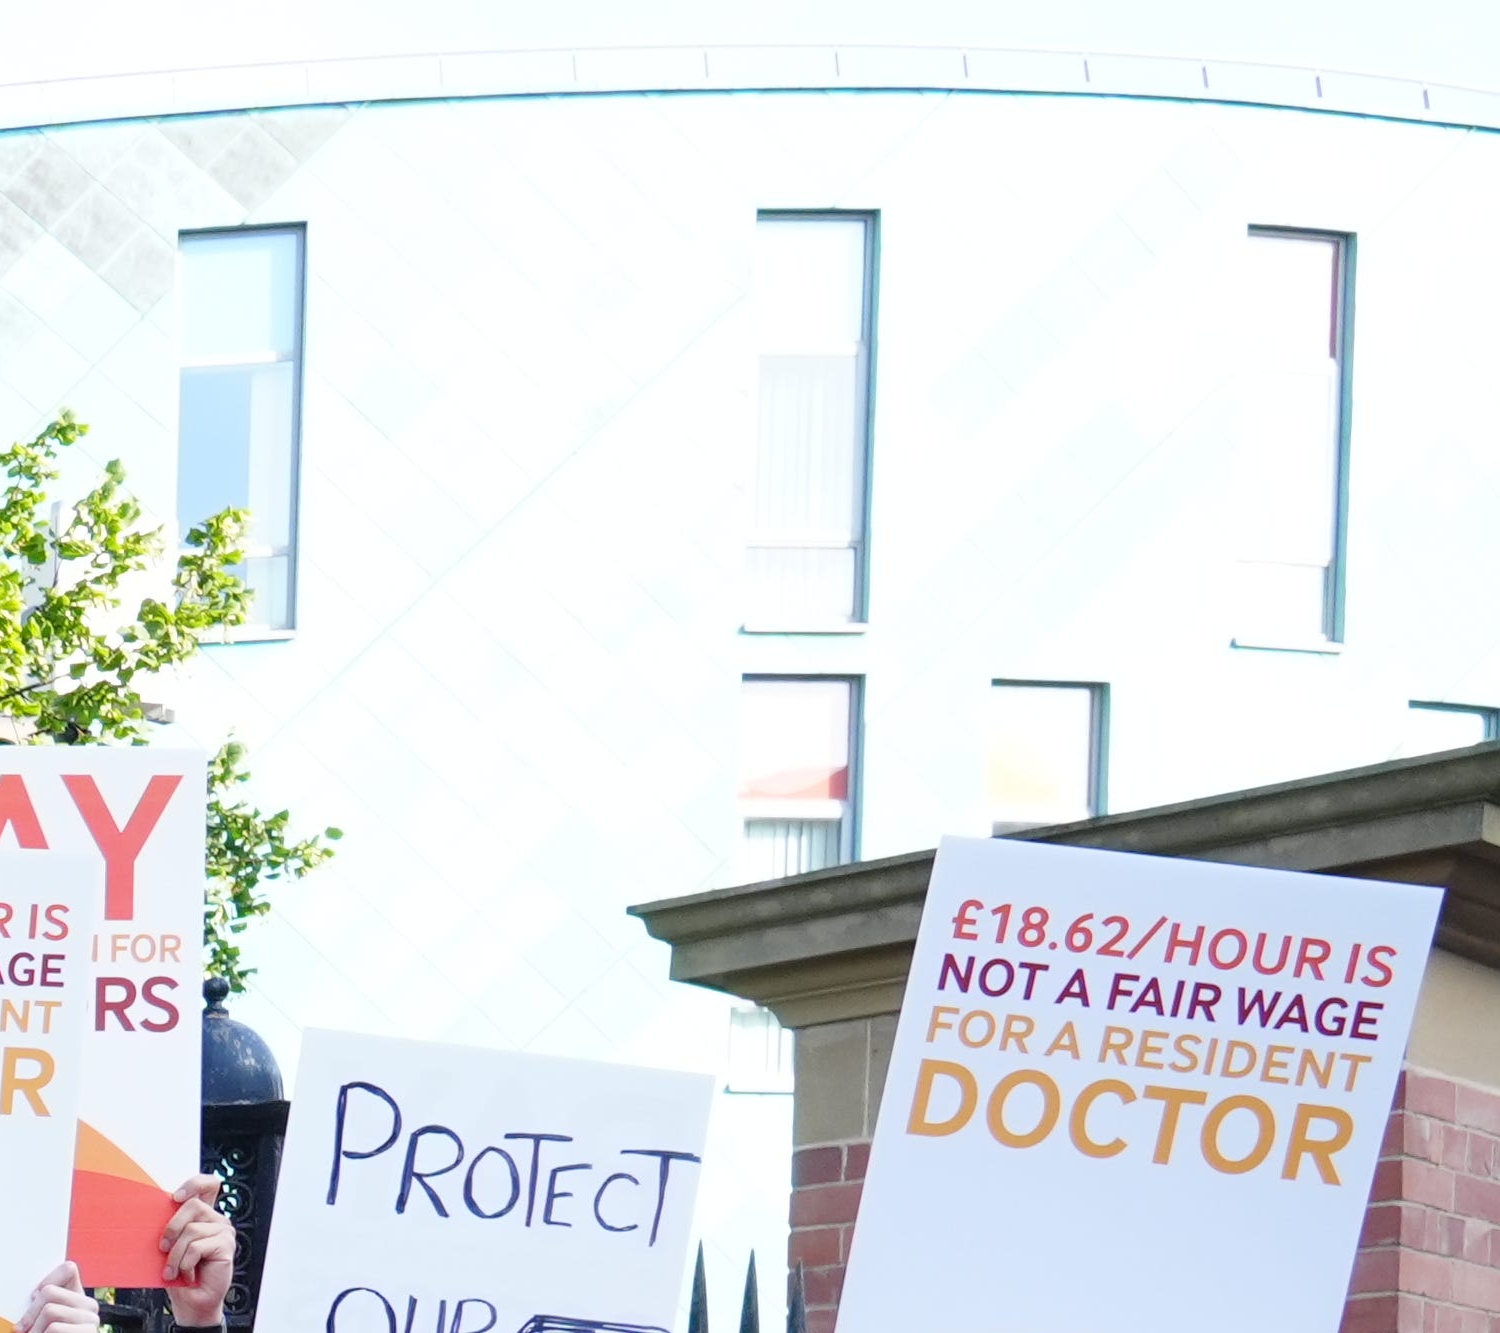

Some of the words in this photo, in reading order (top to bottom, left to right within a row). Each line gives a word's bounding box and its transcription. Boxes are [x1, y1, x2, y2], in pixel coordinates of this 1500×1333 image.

[29, 904, 69, 941] IS
[111, 934, 181, 963] FOR
[952, 900, 1331, 980] £18.62/HOUR
[1345, 944, 1396, 987] IS
[938, 954, 1049, 1000] NOT
[1055, 969, 1089, 1007] A
[1107, 973, 1221, 1022] FAIR
[1238, 987, 1384, 1040] WAGE
[926, 1006, 1034, 1053] FOR
[1044, 1021, 1080, 1060] A
[1099, 1026, 1372, 1092] RESIDENT
[327, 1081, 700, 1247] PROTECT
[907, 1059, 1353, 1186] DOCTOR
